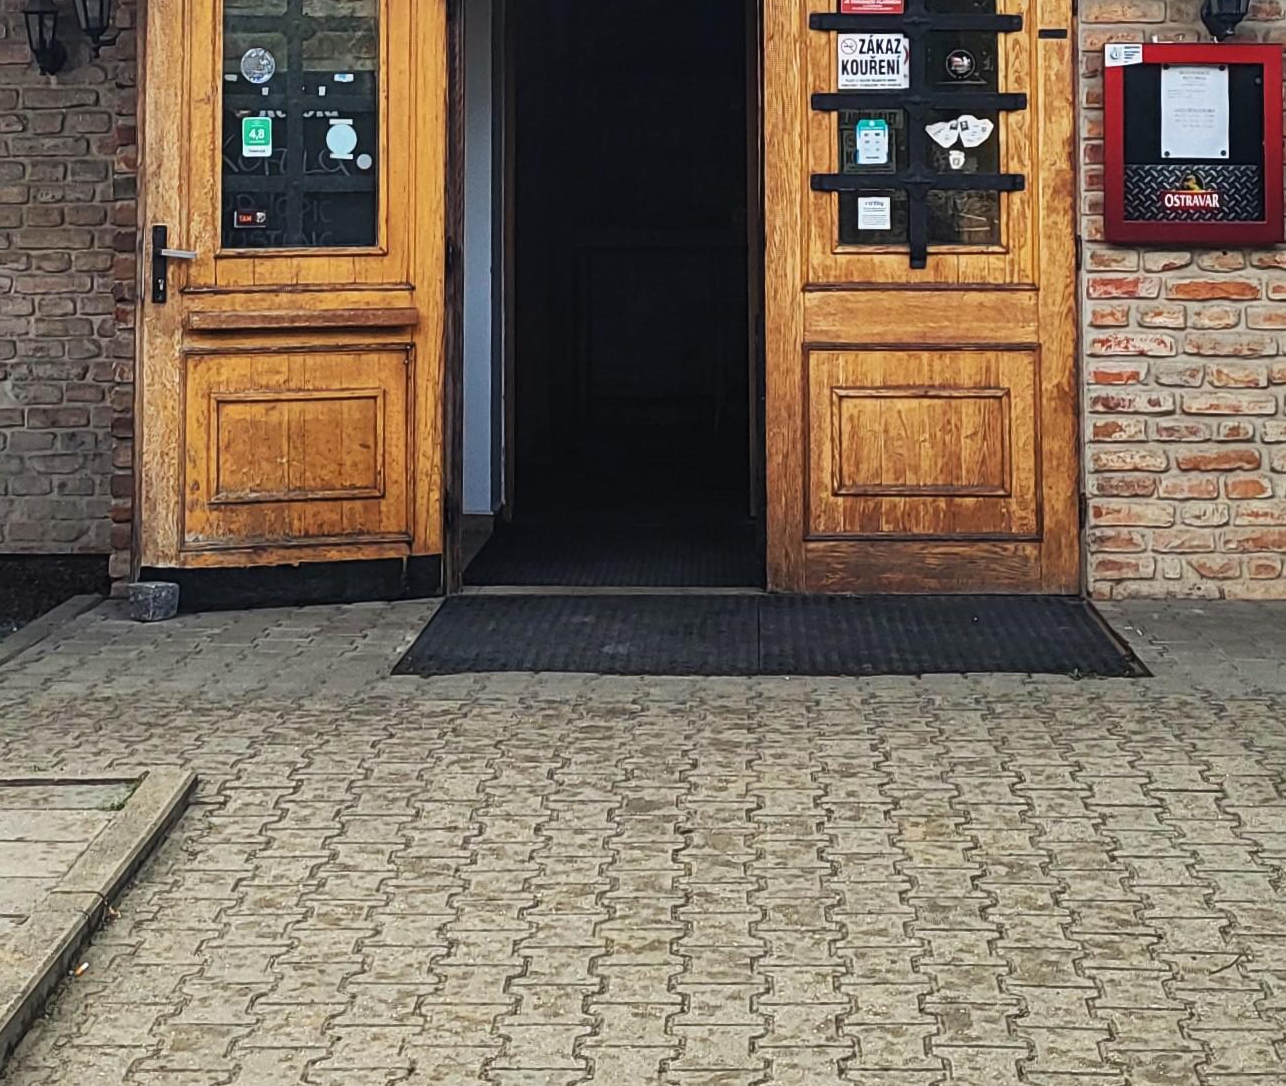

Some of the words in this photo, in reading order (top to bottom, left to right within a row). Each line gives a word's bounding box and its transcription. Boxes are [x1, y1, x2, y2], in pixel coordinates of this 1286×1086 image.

[858, 34, 902, 55] ZÁKAZ
[841, 55, 901, 76] KOUŘENÍ
[1164, 193, 1220, 208] OSTRAVAR
